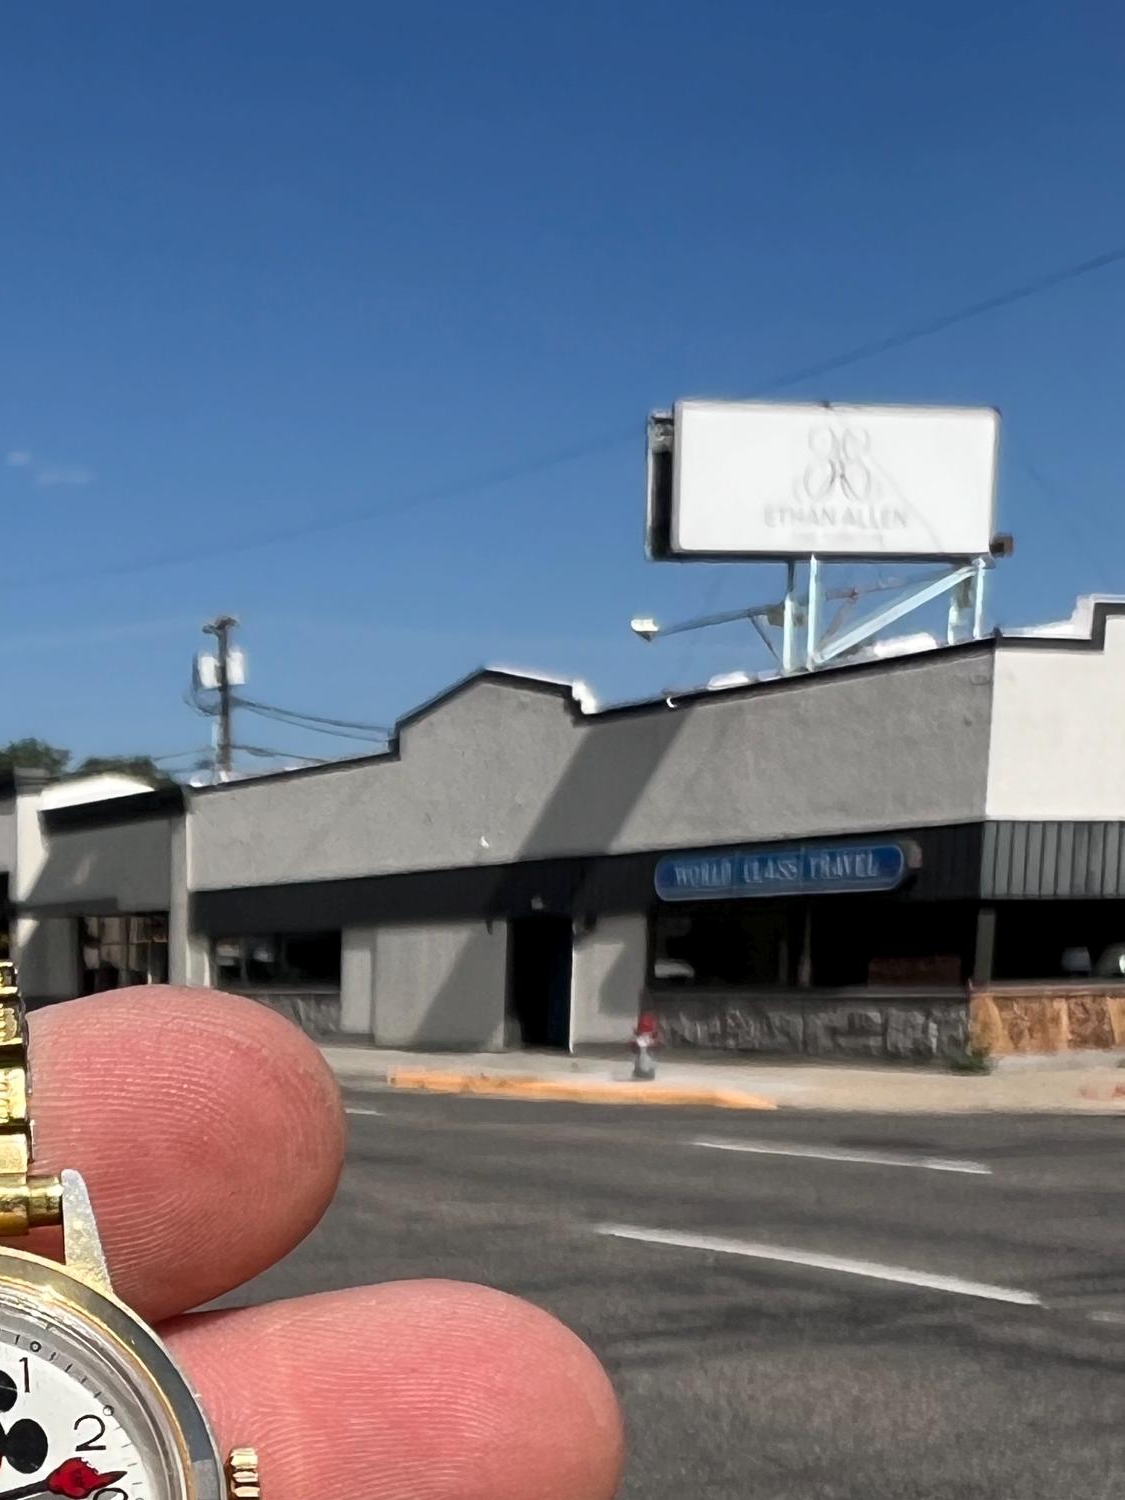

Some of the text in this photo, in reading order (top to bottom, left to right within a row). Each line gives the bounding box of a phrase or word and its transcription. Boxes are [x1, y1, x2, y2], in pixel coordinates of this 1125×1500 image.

[764, 503, 908, 529] ETHAN ALLEN
[810, 850, 879, 880] TRAVEL
[18, 1358, 31, 1393] 1
[74, 1414, 106, 1451] 2
